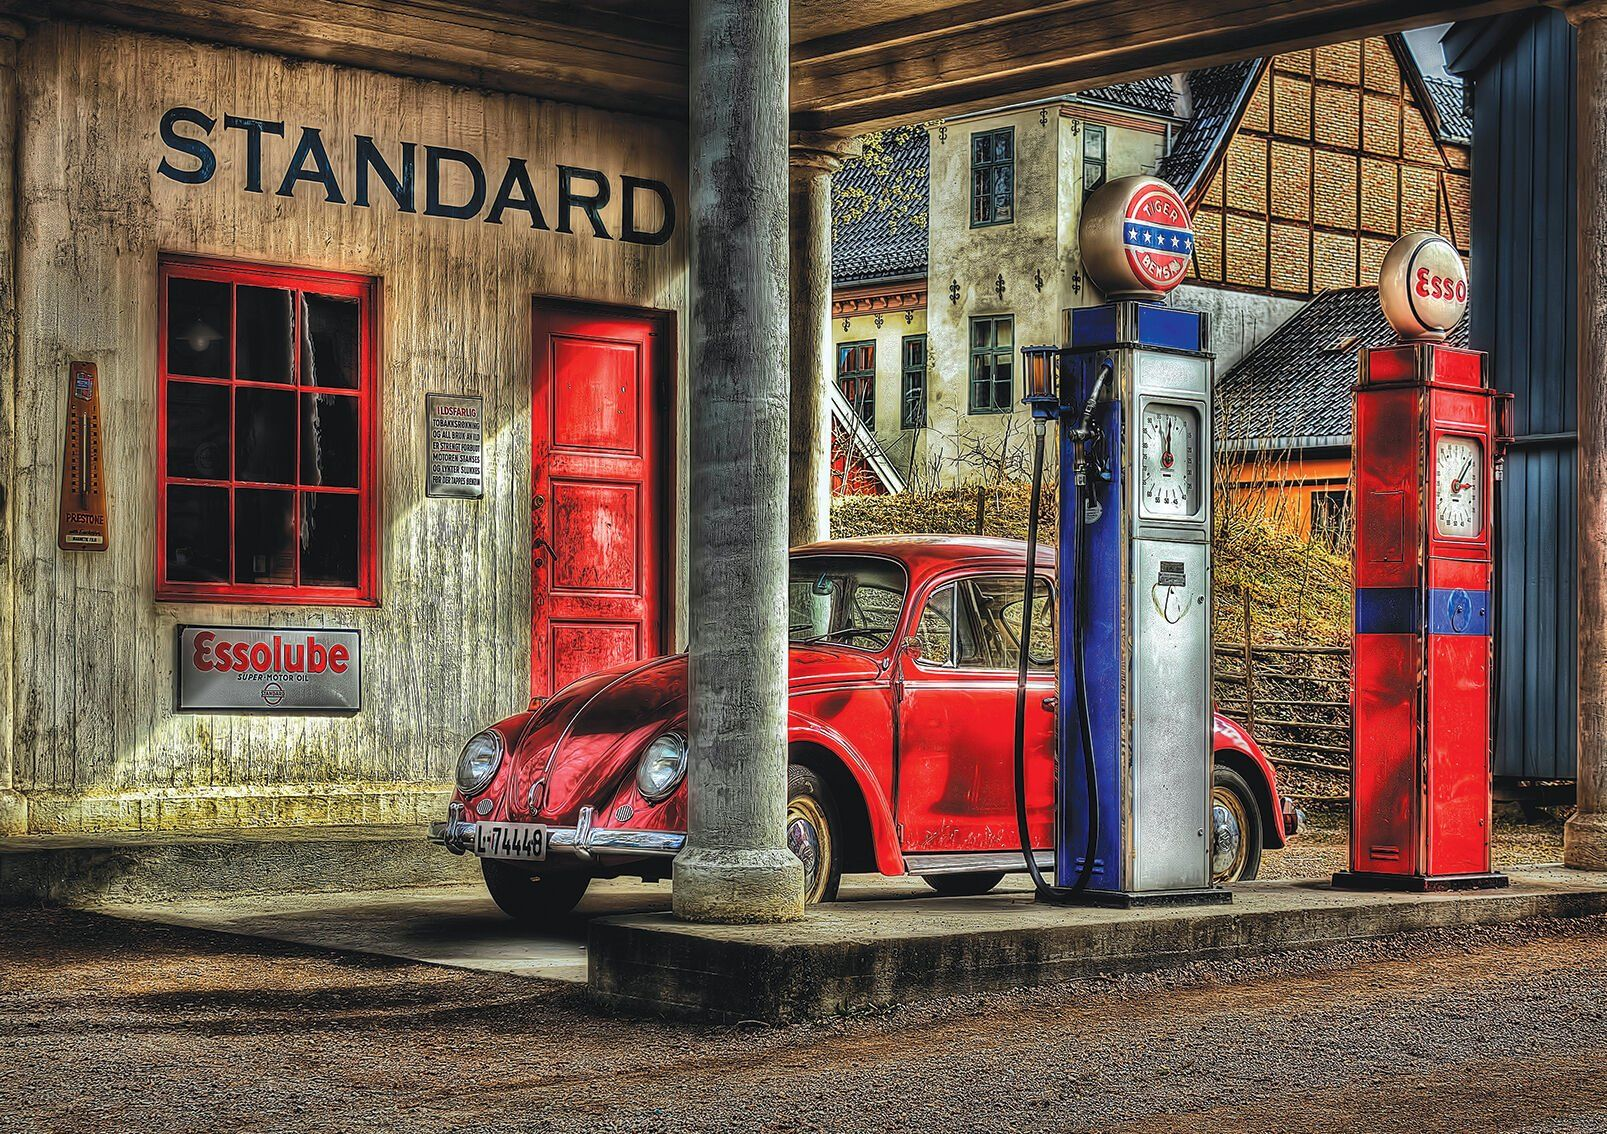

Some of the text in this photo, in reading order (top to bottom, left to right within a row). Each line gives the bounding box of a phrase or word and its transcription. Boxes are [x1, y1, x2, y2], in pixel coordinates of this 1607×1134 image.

[156, 106, 677, 247] STANDARD
[1142, 199, 1179, 223] TIGER
[436, 406, 477, 418] ILDSFARLIG
[432, 430, 441, 439] OG
[442, 431, 451, 439] ALL
[452, 432, 465, 440] BRUK
[432, 442, 440, 450] ER
[440, 442, 461, 451] STRENGT
[432, 453, 480, 463] MOTOREN STANSES
[432, 464, 441, 472] OG
[442, 465, 460, 473] LYKTER
[66, 513, 104, 525] PRESTONE
[193, 631, 350, 674] Essolube
[296, 674, 309, 682] OIL
